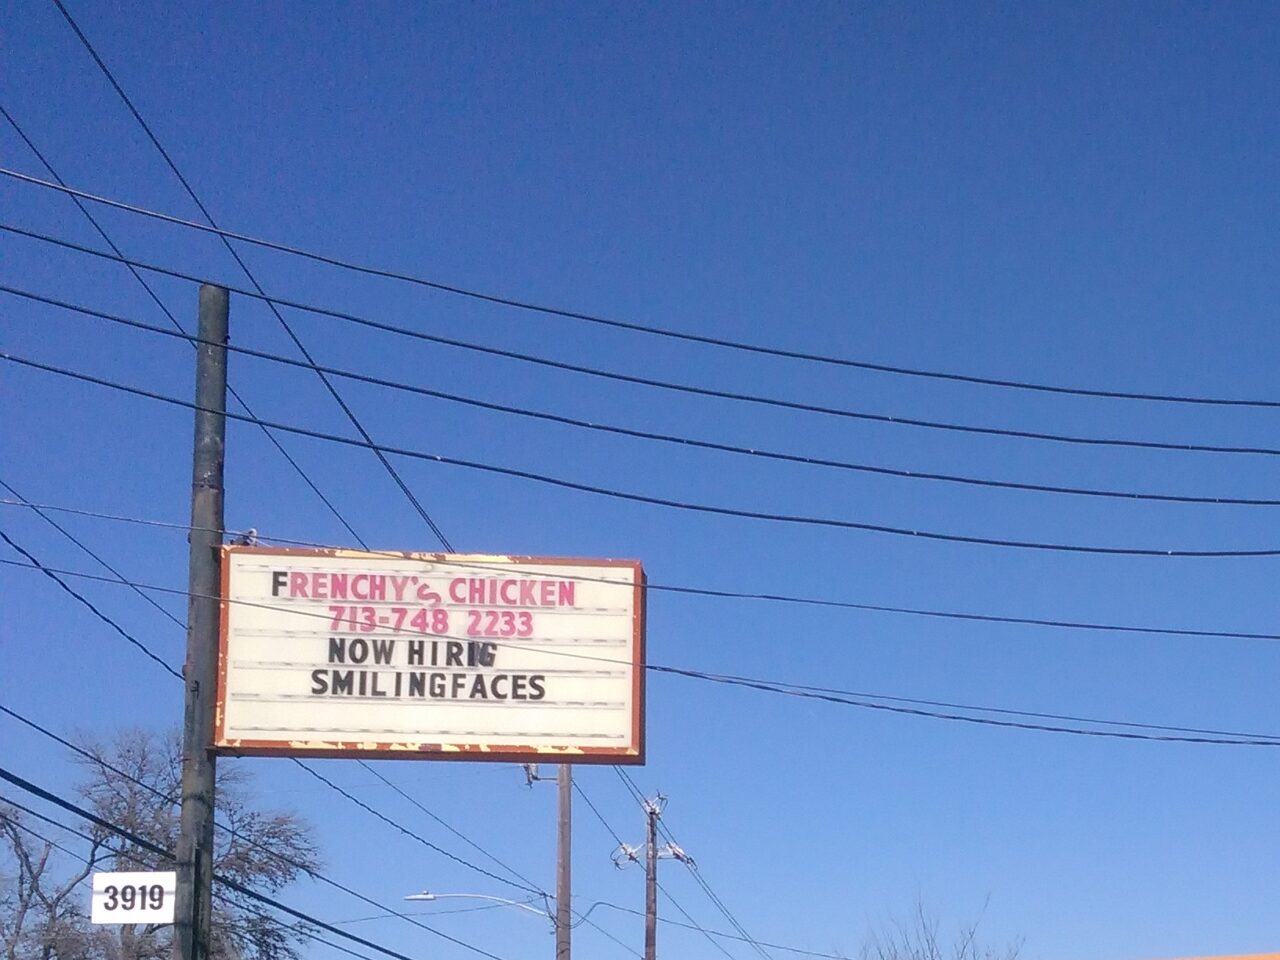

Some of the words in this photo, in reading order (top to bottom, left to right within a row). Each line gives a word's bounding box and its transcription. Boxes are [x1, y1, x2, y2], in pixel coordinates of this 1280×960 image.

[448, 577, 576, 606] CHICKEN
[328, 605, 450, 635] 713-748
[466, 609, 534, 638] 2233
[328, 637, 396, 665] NOW
[103, 884, 165, 911] 3919
